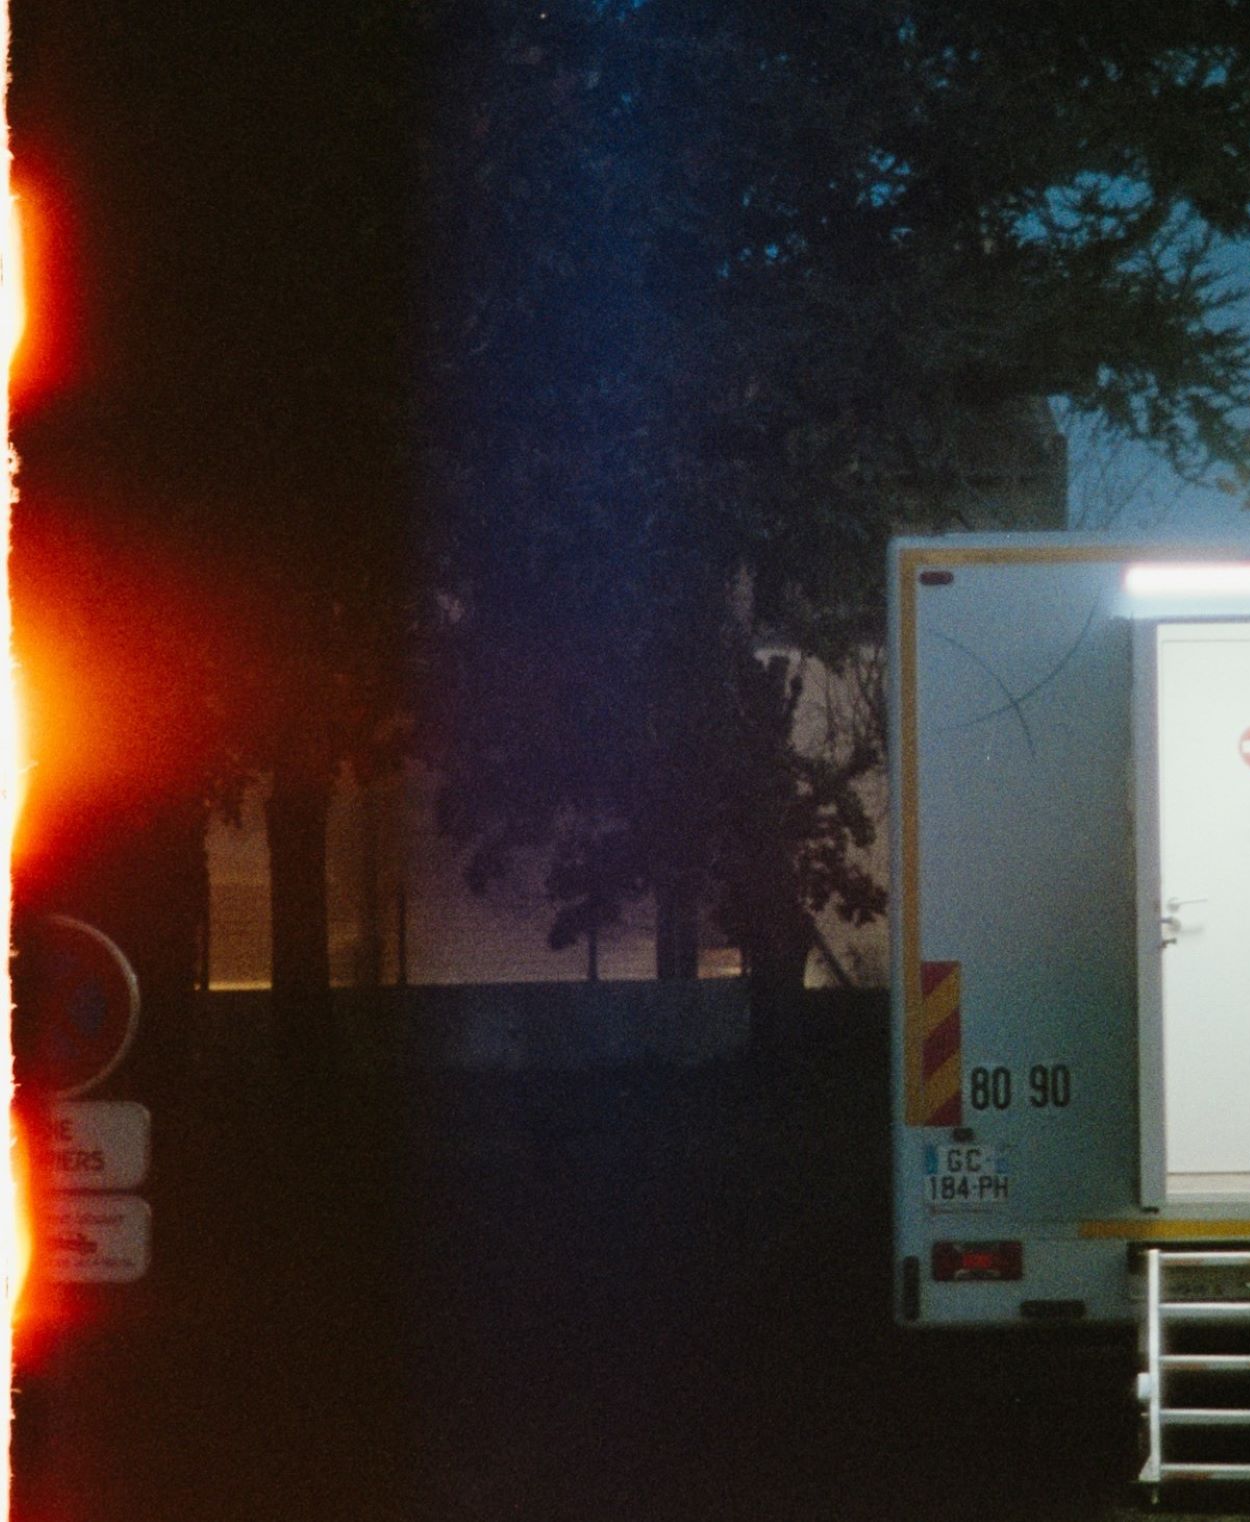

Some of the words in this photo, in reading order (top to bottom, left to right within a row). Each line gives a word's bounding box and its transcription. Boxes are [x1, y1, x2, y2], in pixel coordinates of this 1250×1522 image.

[970, 1067, 1011, 1109] 80
[1030, 1065, 1071, 1107] 90
[930, 1177, 1009, 1200] 184-PH
